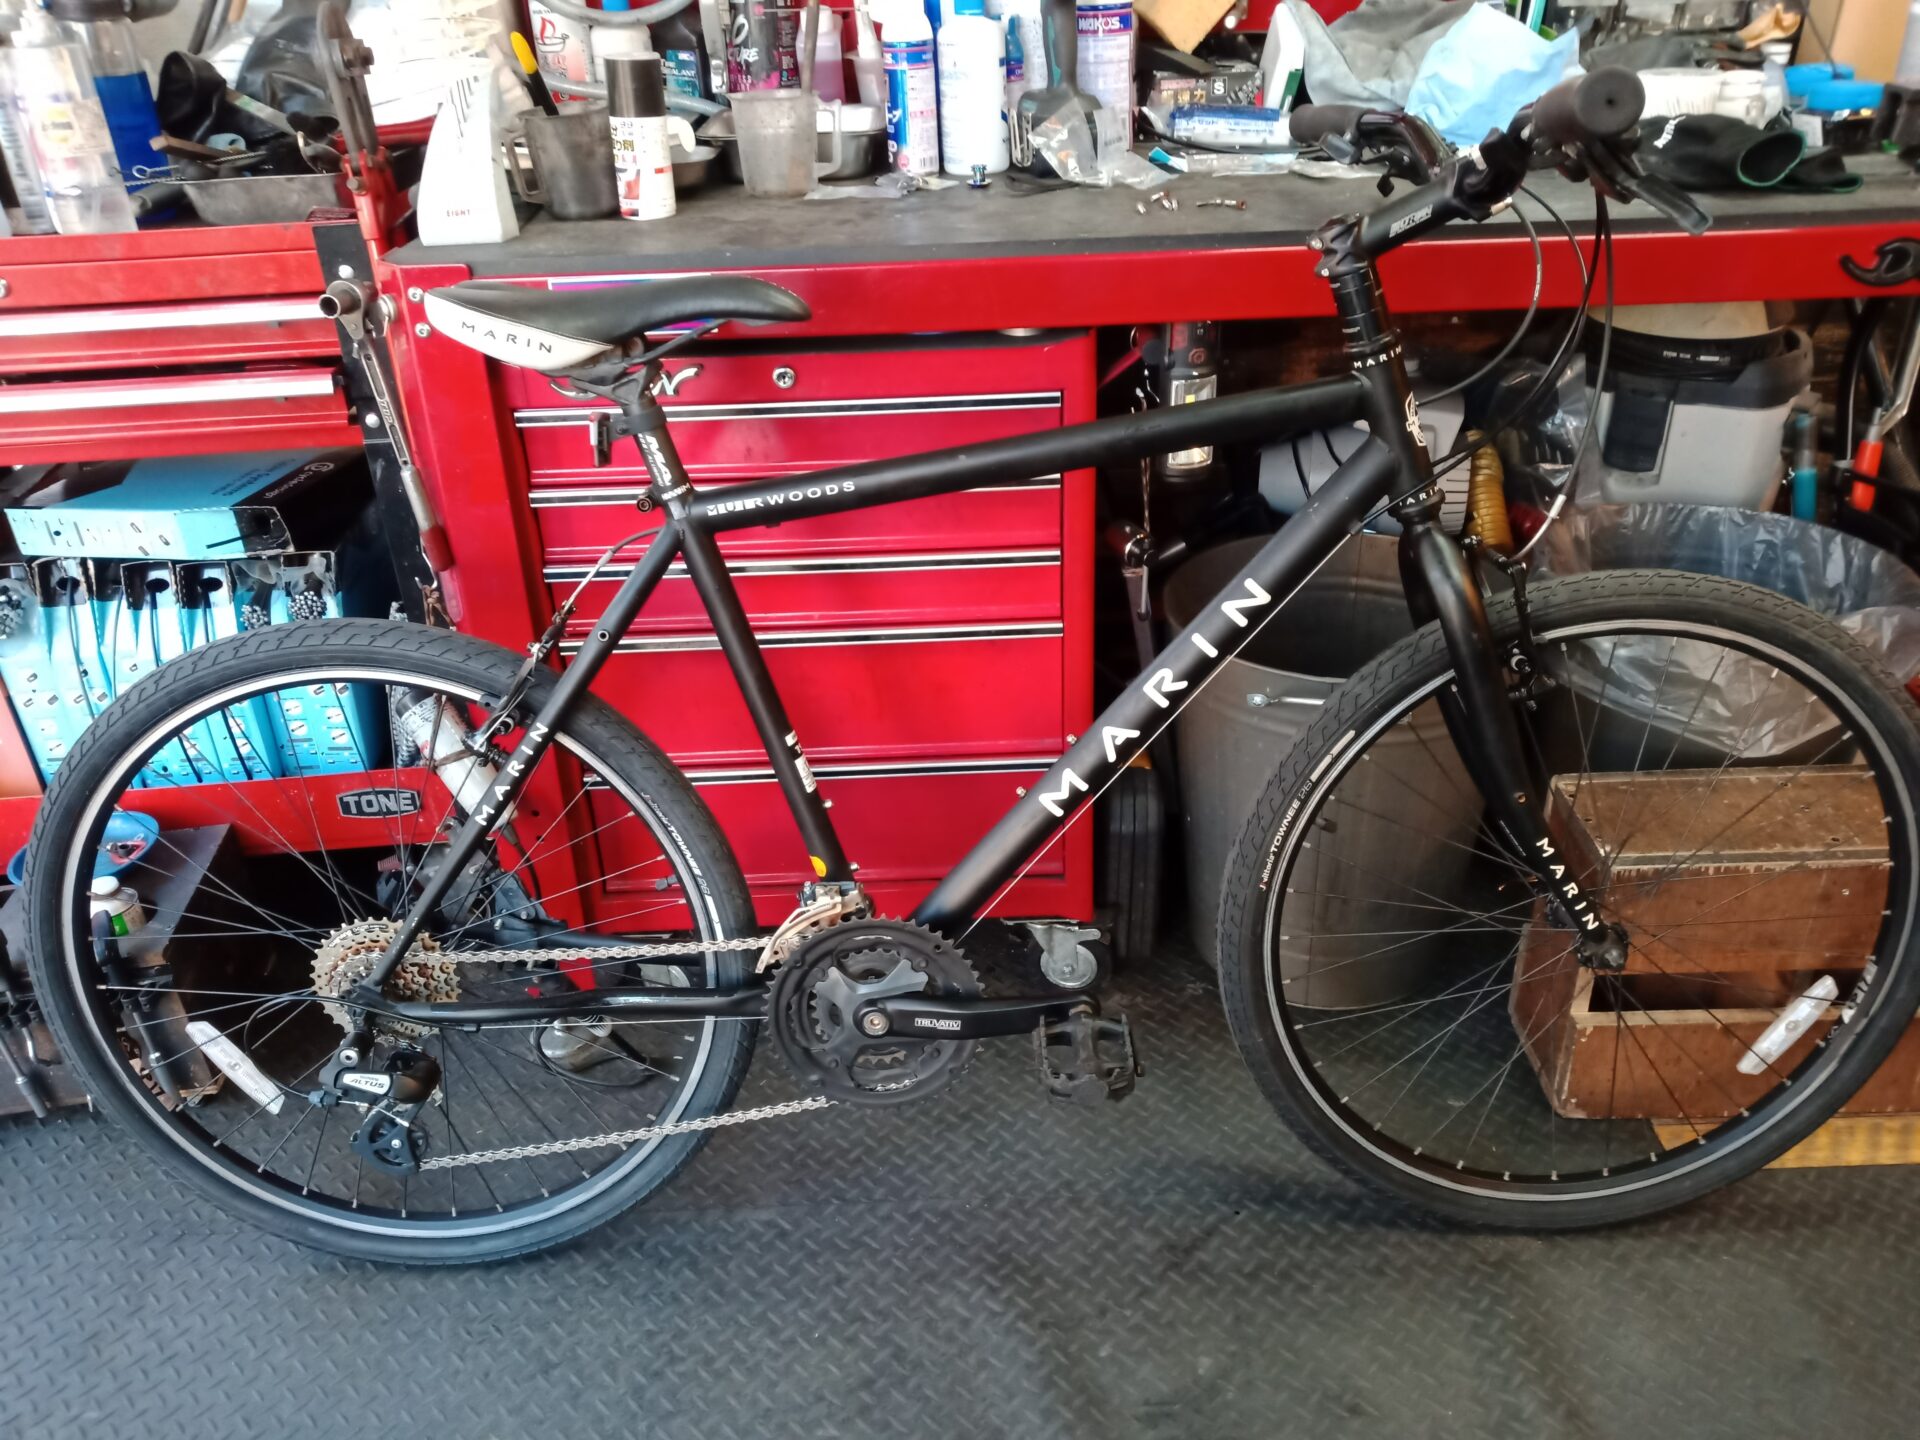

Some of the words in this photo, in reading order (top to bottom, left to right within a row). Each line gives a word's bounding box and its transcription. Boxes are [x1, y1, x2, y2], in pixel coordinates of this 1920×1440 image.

[461, 321, 552, 353] MARIN
[1353, 344, 1402, 369] MARIN
[706, 497, 764, 516] MUIR
[766, 481, 855, 506] WOODS
[1039, 577, 1271, 817] MARIN
[475, 722, 549, 826] MARIN
[342, 792, 414, 814] TONE
[1261, 852, 1275, 883] vittoria
[1269, 799, 1301, 853] TOWNEE
[1298, 780, 1313, 800] 26
[667, 825, 702, 878] TOWNEE
[1536, 837, 1599, 930] MARIN
[915, 1018, 961, 1030] TRUVATIV
[350, 1078, 385, 1088] ALTUS
